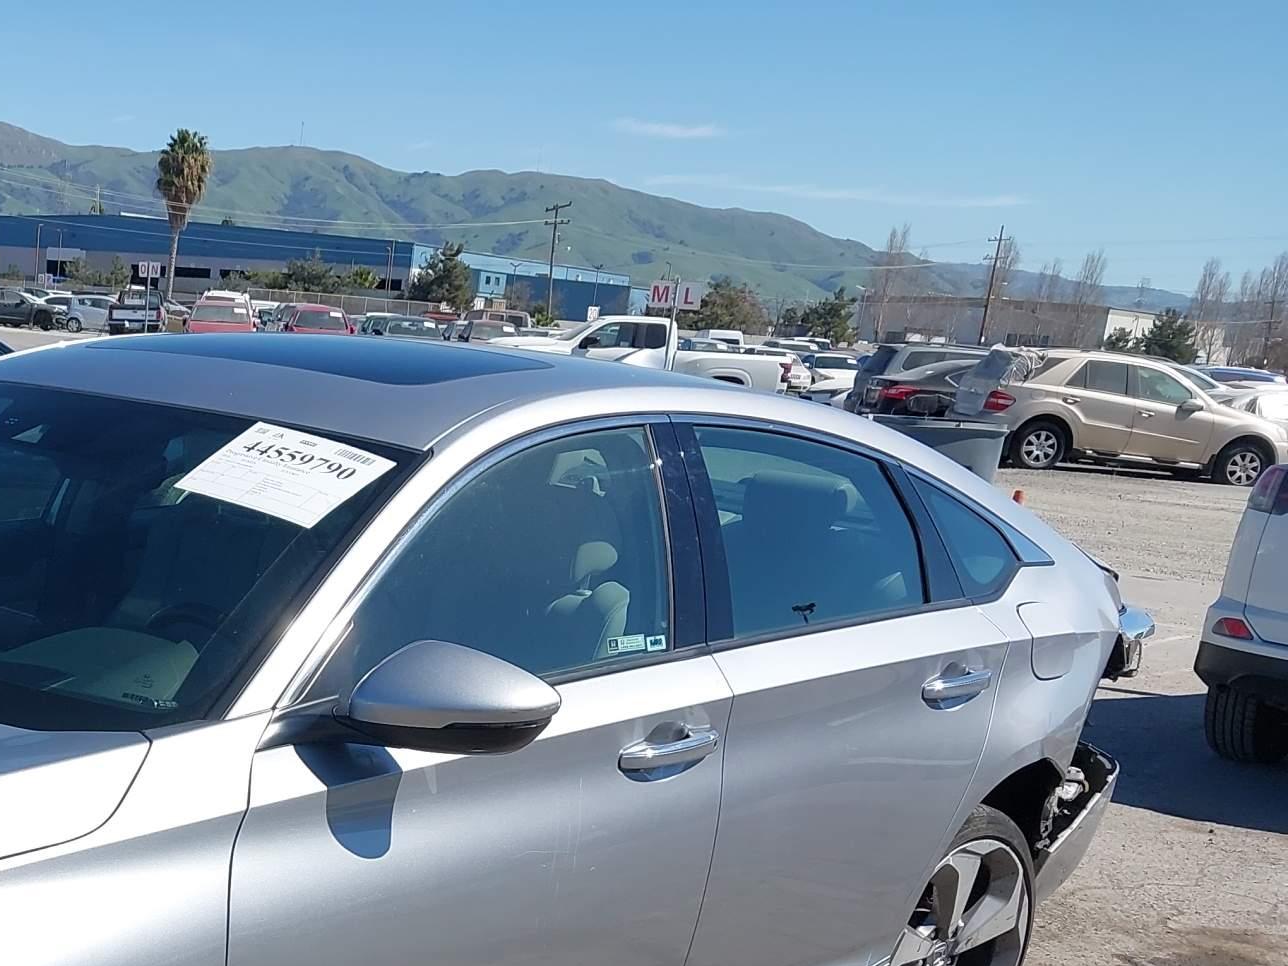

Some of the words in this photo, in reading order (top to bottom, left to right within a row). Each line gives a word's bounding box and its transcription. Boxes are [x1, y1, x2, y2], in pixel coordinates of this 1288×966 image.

[652, 285, 670, 303] M
[683, 287, 694, 305] L
[242, 440, 357, 481] 44559790
